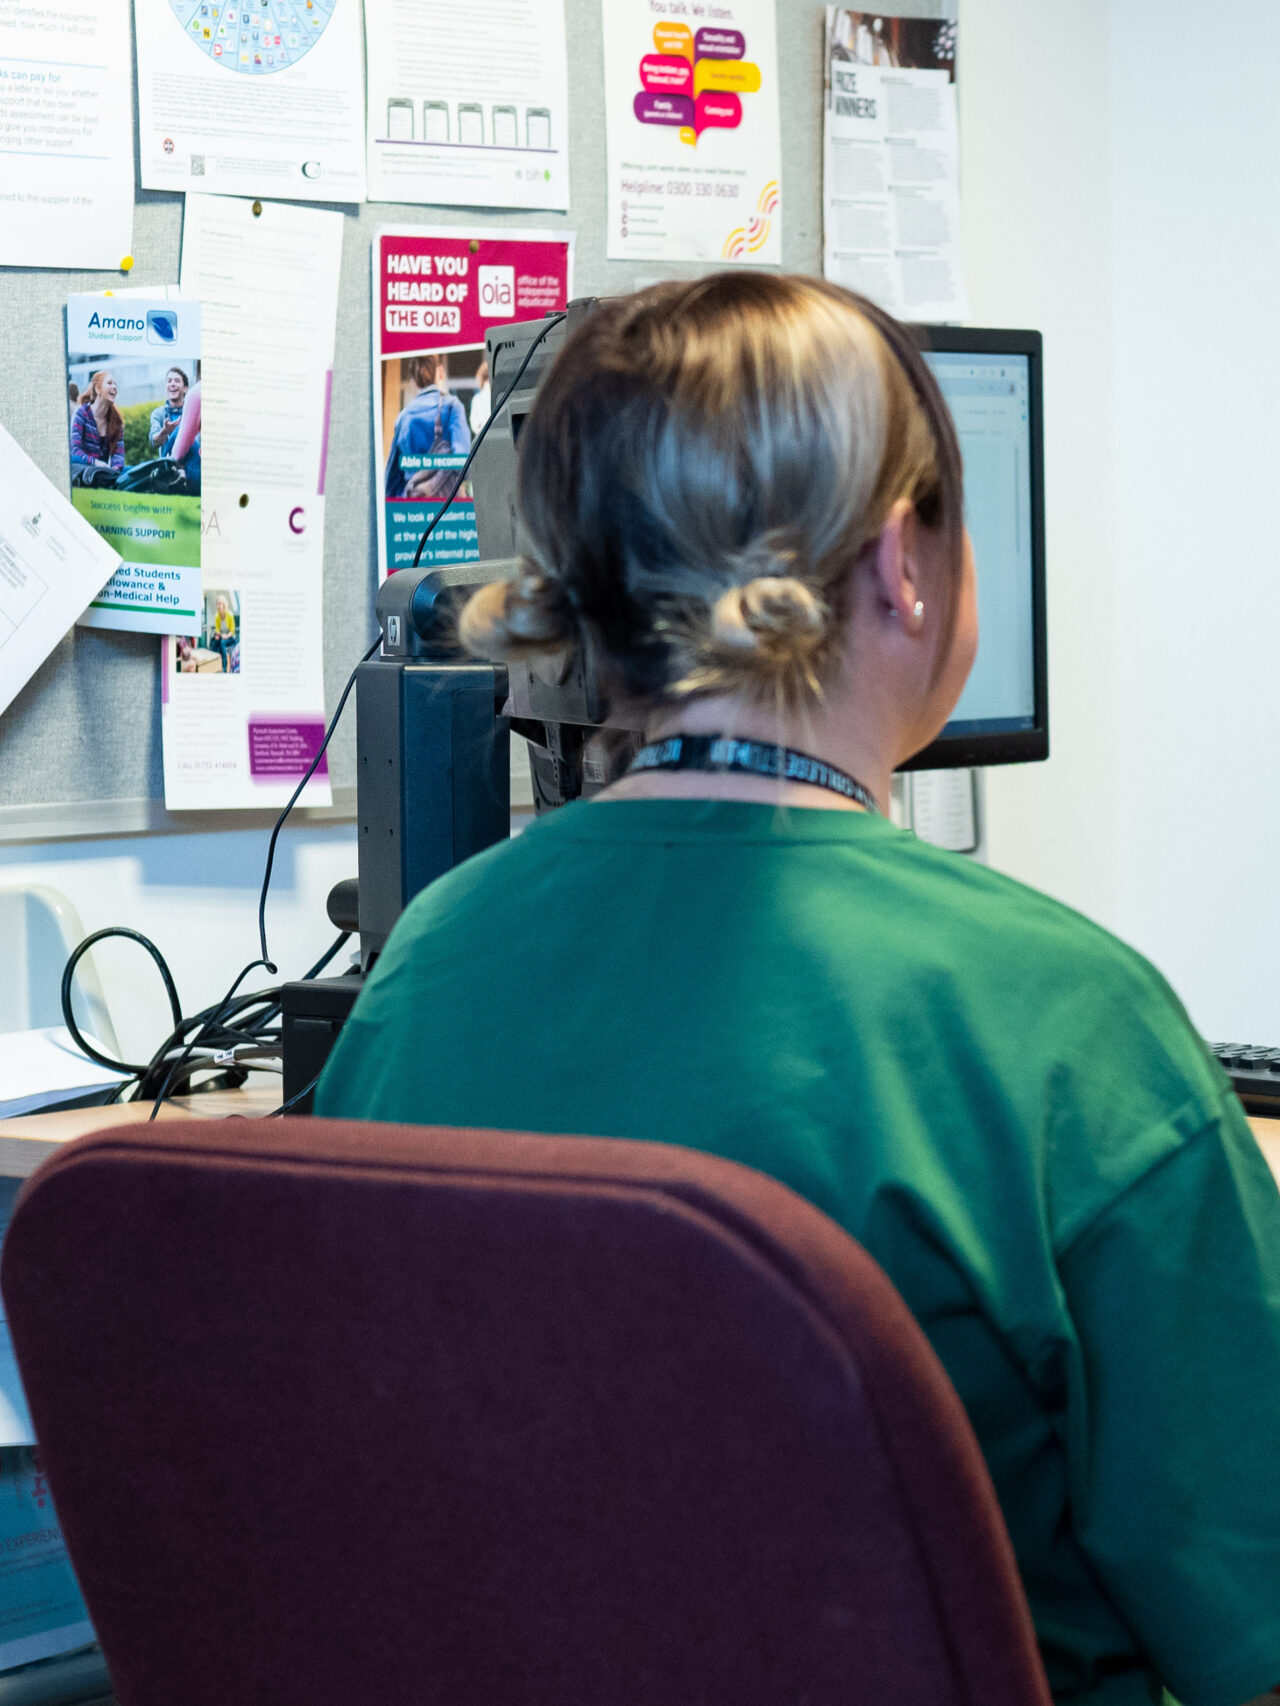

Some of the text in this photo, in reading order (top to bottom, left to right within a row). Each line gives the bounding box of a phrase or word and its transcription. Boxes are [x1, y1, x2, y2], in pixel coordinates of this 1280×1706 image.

[649, 1, 666, 13] You
[693, 4, 707, 17] We
[20, 21, 35, 30] how
[39, 22, 57, 31] much
[11, 72, 27, 80] can
[30, 73, 46, 84] pay
[49, 72, 61, 83] for
[14, 84, 32, 93] letter
[34, 86, 41, 94] to
[43, 86, 55, 95] tell
[57, 89, 69, 98] you
[71, 89, 99, 99] whether
[0, 97, 24, 106] upport
[26, 98, 41, 107] that
[43, 100, 56, 108] has
[10, 111, 54, 121] assessment
[57, 113, 71, 122] can
[72, 113, 82, 123] be
[5, 122, 94, 136] give you instructions for
[24, 136, 43, 145] other
[667, 180, 692, 196] 0300
[695, 181, 712, 197] 330
[17, 193, 24, 202] to
[27, 193, 39, 202] the
[41, 194, 71, 206] supplier
[72, 195, 80, 204] of
[81, 196, 93, 205] the
[387, 254, 468, 276] HAVE YOU
[387, 281, 468, 303] HEARD OF
[482, 275, 511, 305] oia
[88, 312, 145, 330] Amano
[389, 310, 457, 328] THE OIA?
[88, 332, 143, 343] Student Support
[401, 456, 468, 468] Able to recomm
[90, 500, 172, 515] Success begins with
[393, 512, 406, 523] We
[408, 512, 424, 523] look
[95, 524, 176, 540] EARNING SUPPORT
[394, 532, 402, 542] at
[403, 532, 416, 542] the
[418, 530, 434, 541] ed
[435, 530, 443, 540] of
[445, 530, 458, 540] the
[395, 549, 433, 563] provier's
[435, 549, 464, 559] internal
[134, 568, 182, 581] Students
[106, 578, 166, 591] llowance &
[98, 590, 181, 606] on-Medical Help
[177, 762, 192, 770] CALL
[6, 1529, 62, 1552] EXPERIEN
